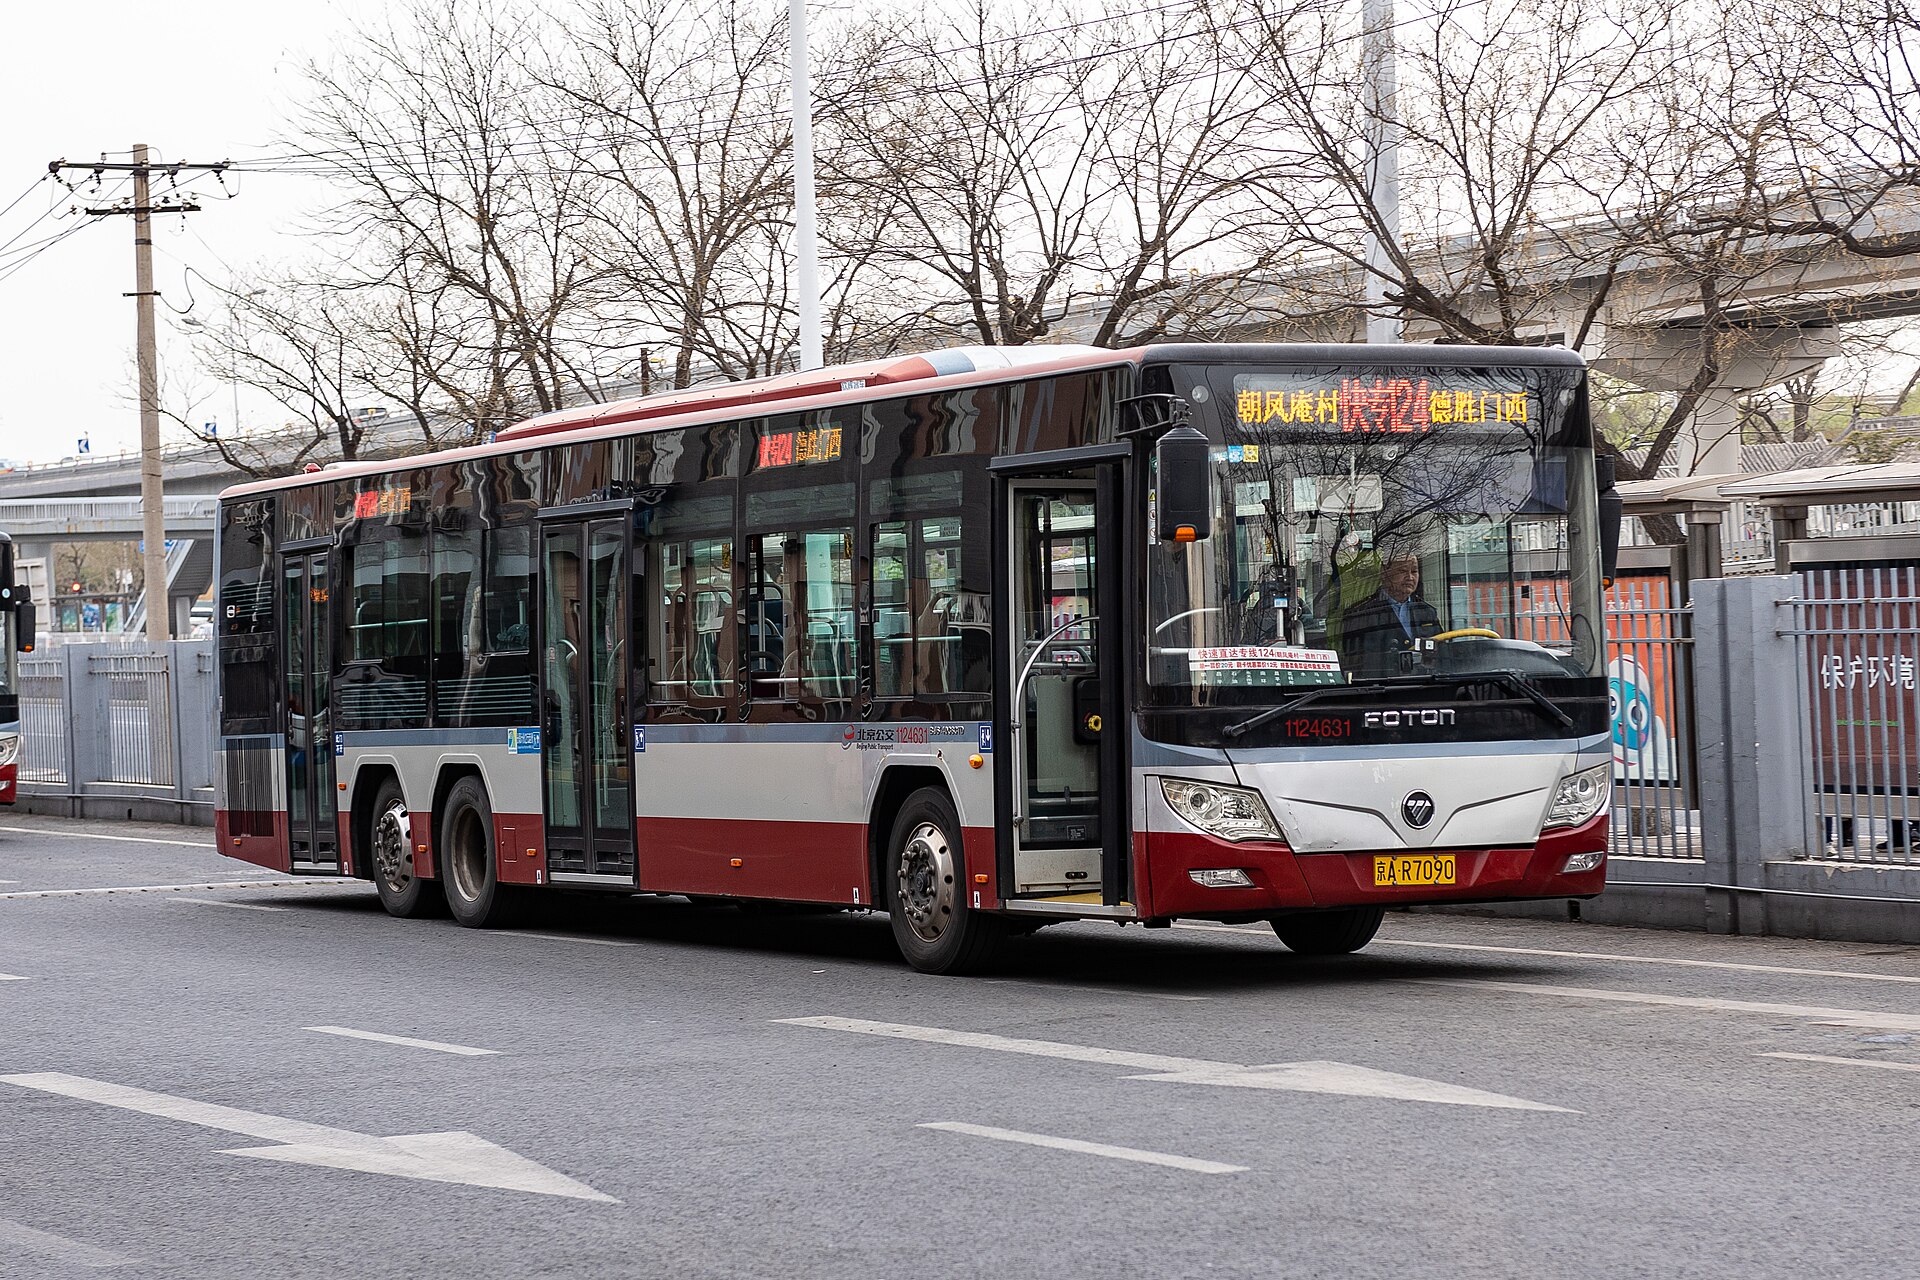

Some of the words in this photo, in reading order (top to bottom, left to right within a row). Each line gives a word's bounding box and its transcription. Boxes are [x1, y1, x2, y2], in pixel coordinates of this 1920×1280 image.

[1237, 389, 1340, 423] 朝凤庵村
[1339, 378, 1430, 432] 快专124
[1429, 390, 1528, 423] 德胜门西
[1821, 655, 1915, 689] 保护环境
[857, 729, 894, 741] 北京公交
[896, 726, 929, 744] 1124631
[1285, 719, 1351, 737] 1124631
[1364, 709, 1456, 728] FOTON
[1376, 860, 1454, 881] 京A·R7090
